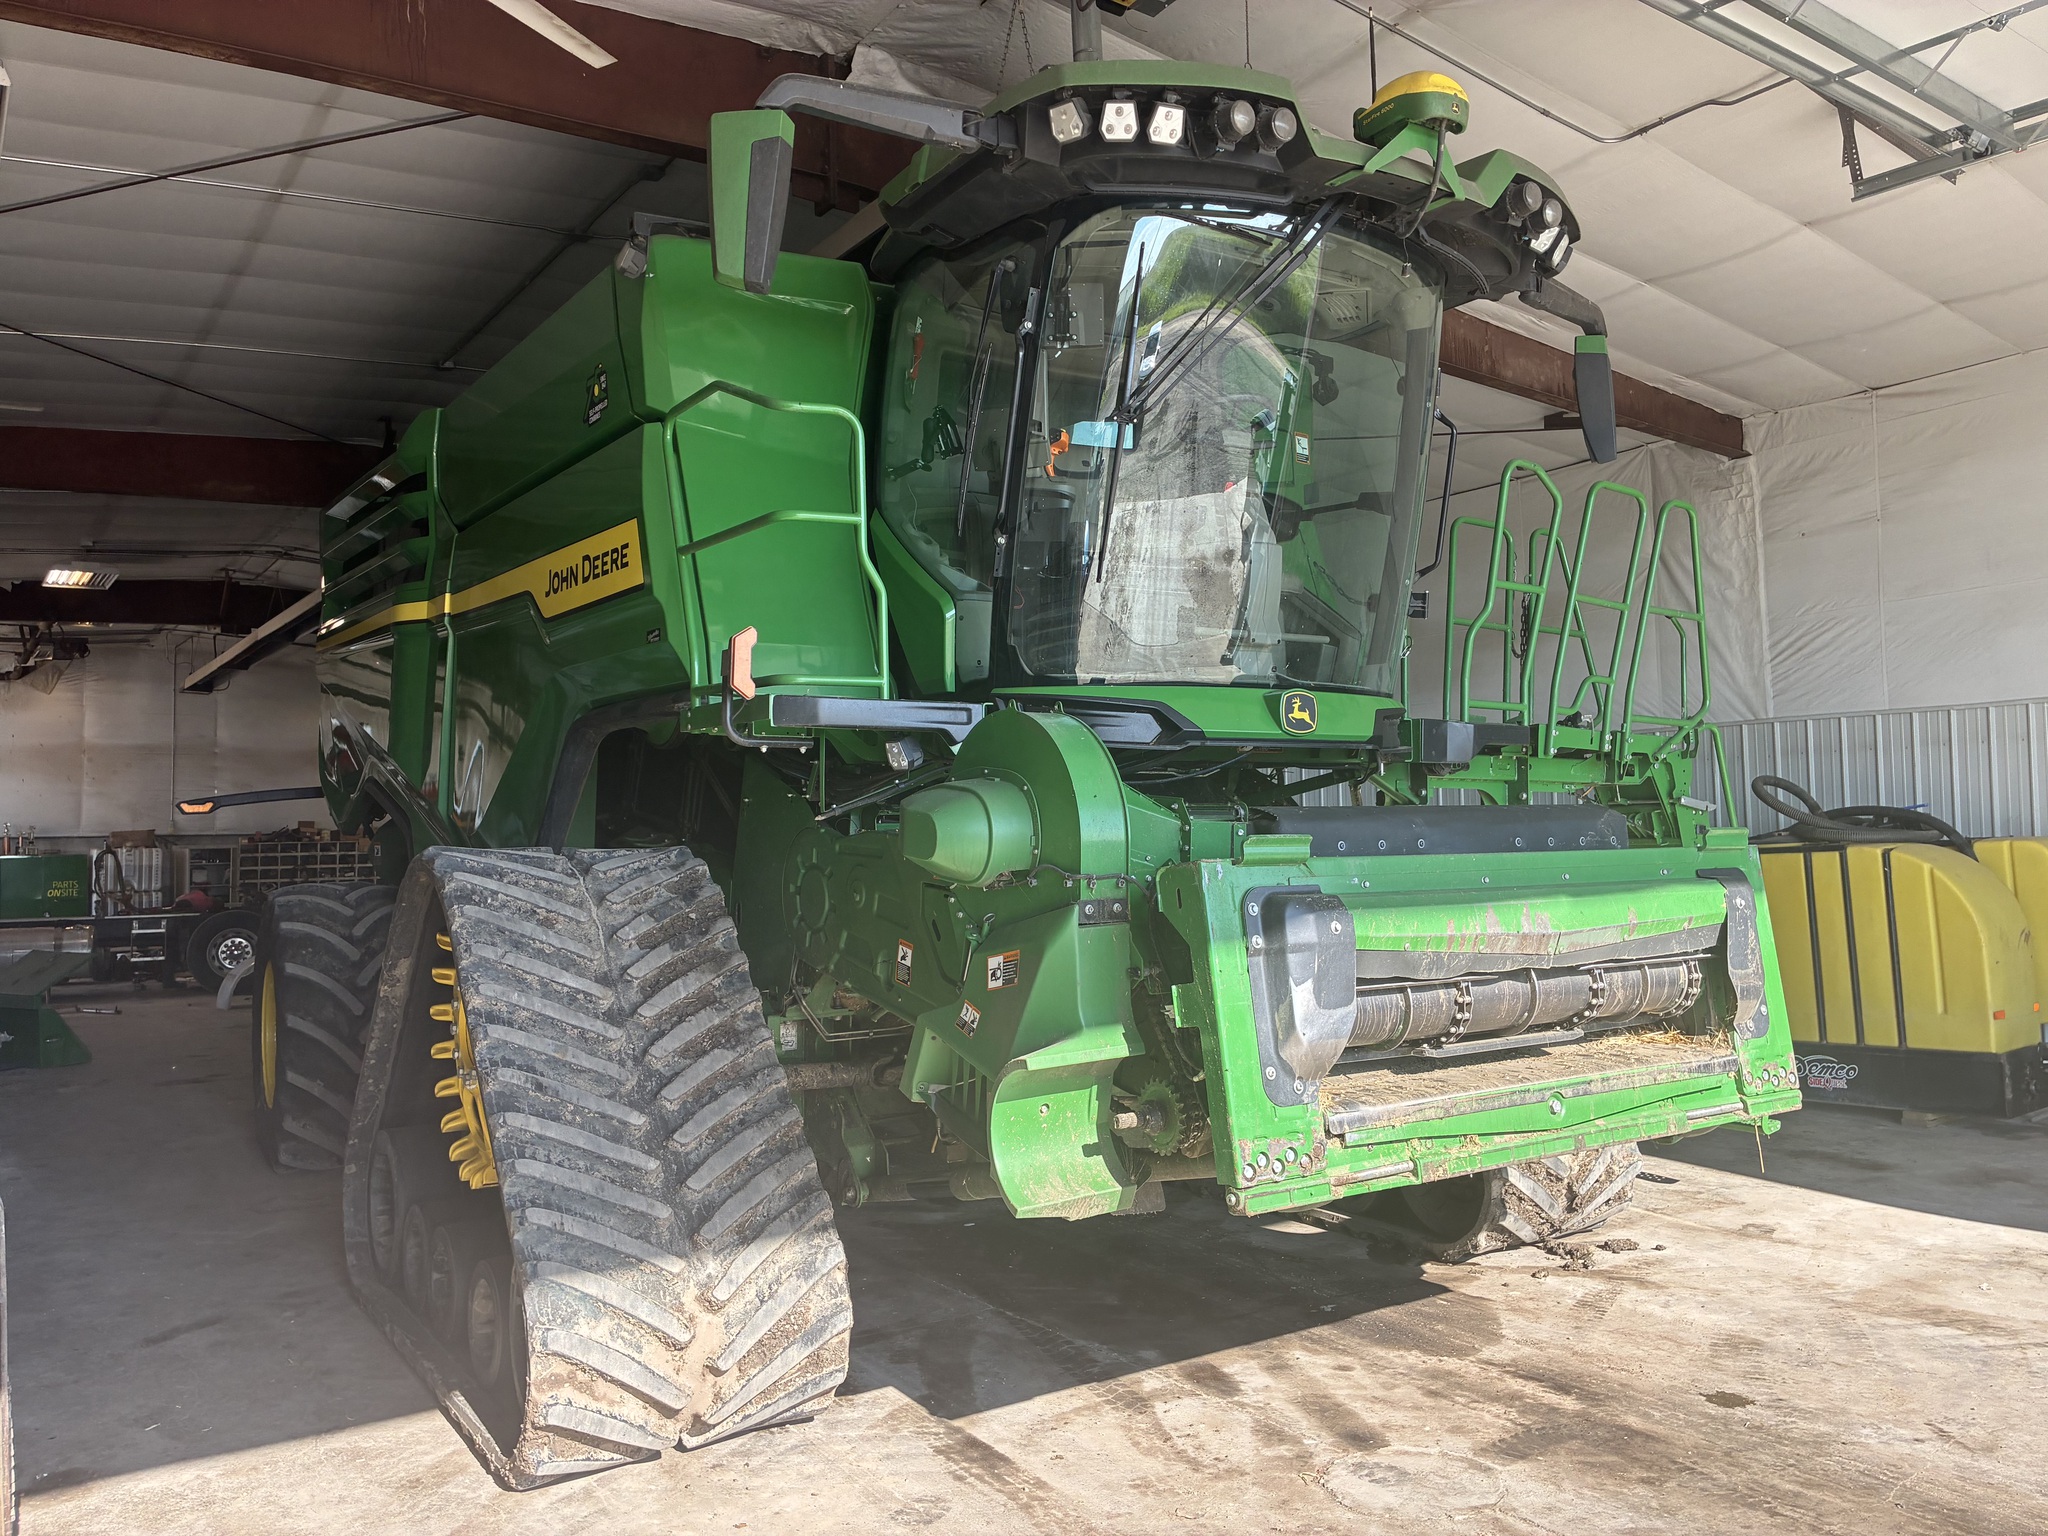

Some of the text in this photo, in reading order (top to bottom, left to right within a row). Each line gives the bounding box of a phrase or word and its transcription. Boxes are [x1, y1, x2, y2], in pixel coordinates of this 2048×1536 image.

[545, 542, 630, 598] JOHN DEERE
[52, 880, 79, 889] PARTS
